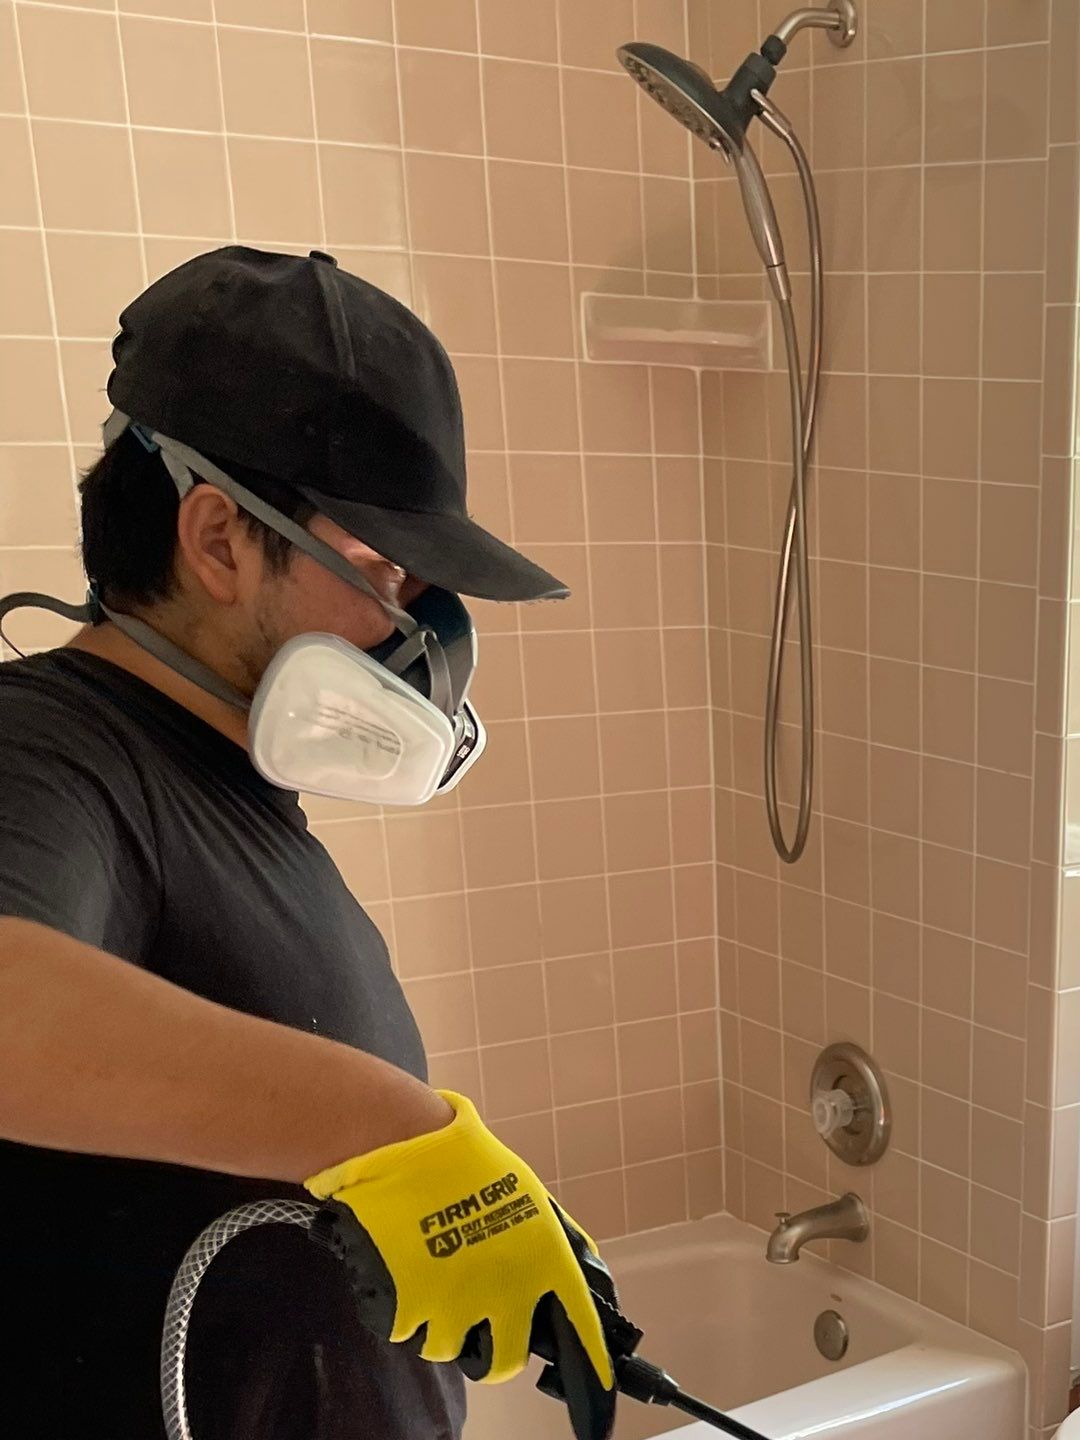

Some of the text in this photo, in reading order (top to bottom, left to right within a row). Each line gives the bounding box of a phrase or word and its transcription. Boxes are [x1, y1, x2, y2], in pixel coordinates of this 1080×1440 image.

[420, 1172, 519, 1234] FIRM GRIP
[461, 1218, 482, 1234] CUT
[435, 1232, 459, 1254] A1
